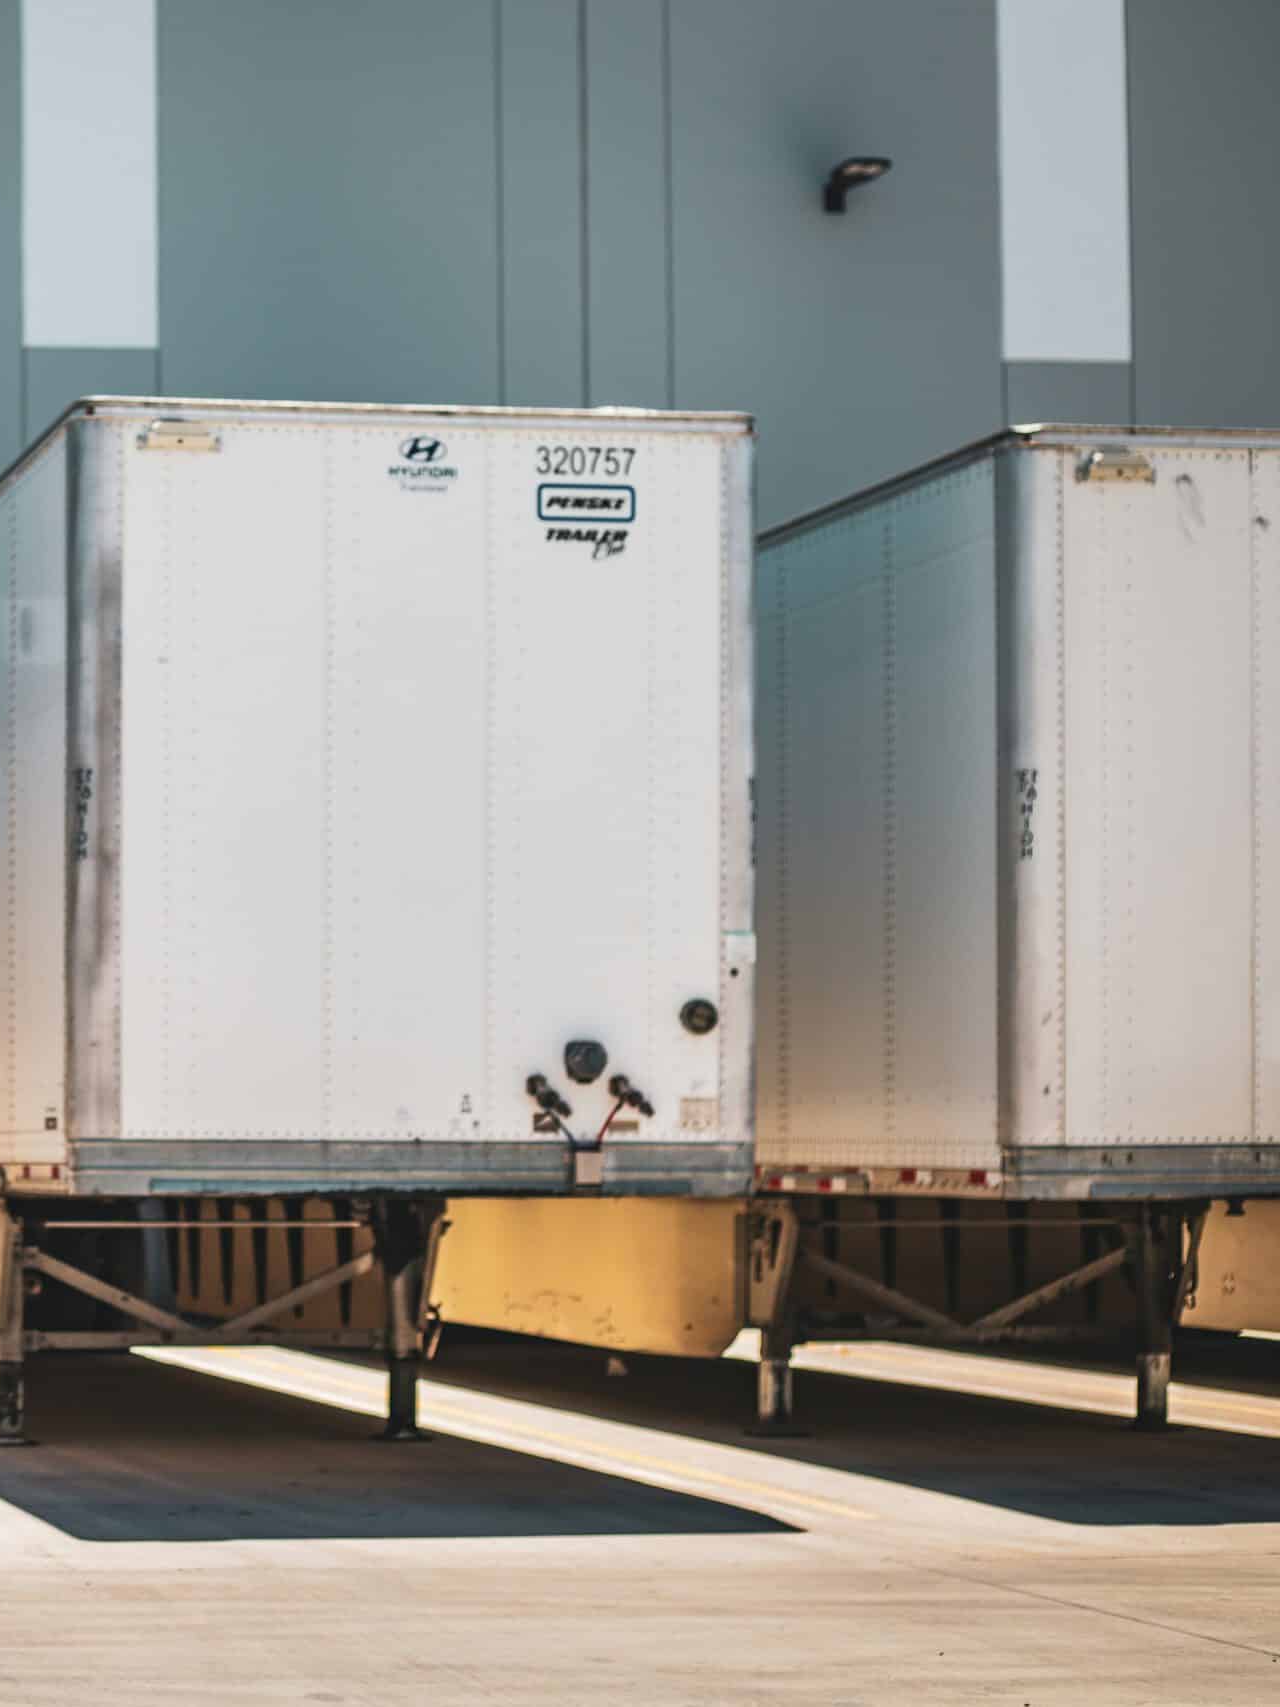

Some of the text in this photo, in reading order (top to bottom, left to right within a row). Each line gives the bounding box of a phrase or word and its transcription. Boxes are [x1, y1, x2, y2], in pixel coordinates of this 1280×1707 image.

[536, 445, 636, 476] 320757
[546, 496, 625, 510] PENSKE
[545, 528, 629, 543] TRAILER
